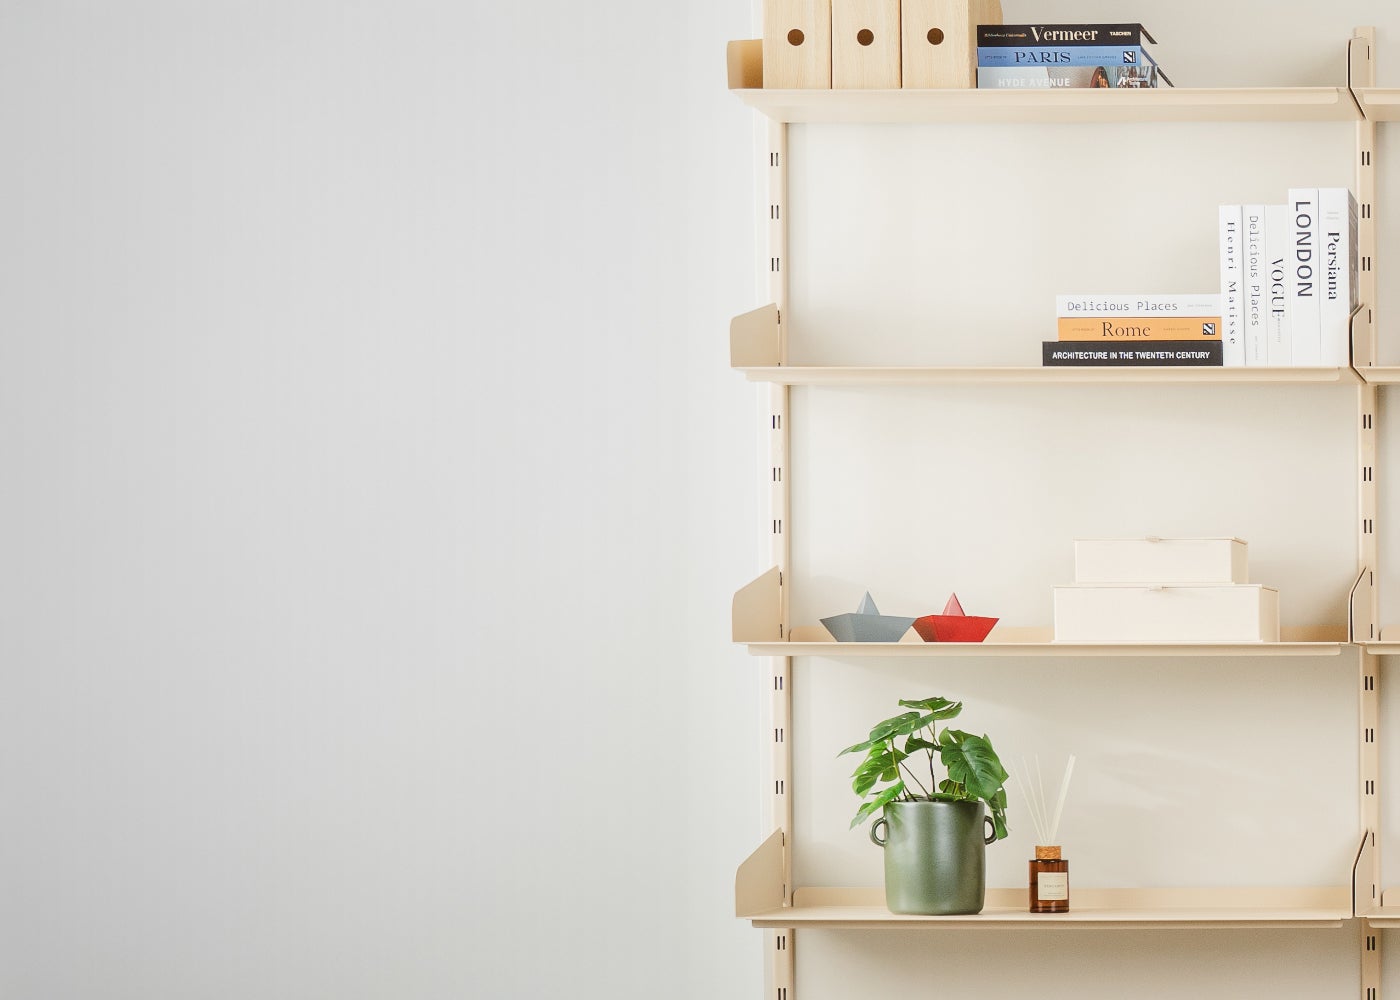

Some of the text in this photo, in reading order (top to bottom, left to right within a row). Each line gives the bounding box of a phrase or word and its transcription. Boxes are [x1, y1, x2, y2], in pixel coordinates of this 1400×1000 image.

[1030, 26, 1099, 43] Vermeer
[1014, 51, 1071, 63] PARIS
[998, 78, 1071, 87] HYDE AVENUE
[1295, 201, 1313, 297] LONDON
[1249, 215, 1261, 326] Delicious Places
[1327, 232, 1341, 300] Persiana
[1227, 222, 1238, 345] Henri Matisse
[1271, 258, 1285, 318] VOGUE
[1067, 301, 1130, 311] Delicious
[1137, 301, 1178, 311] Places
[1102, 321, 1151, 337] Rome
[1052, 351, 1210, 360] ARCHITECTURE IN THE TWENTETH CENTURY
